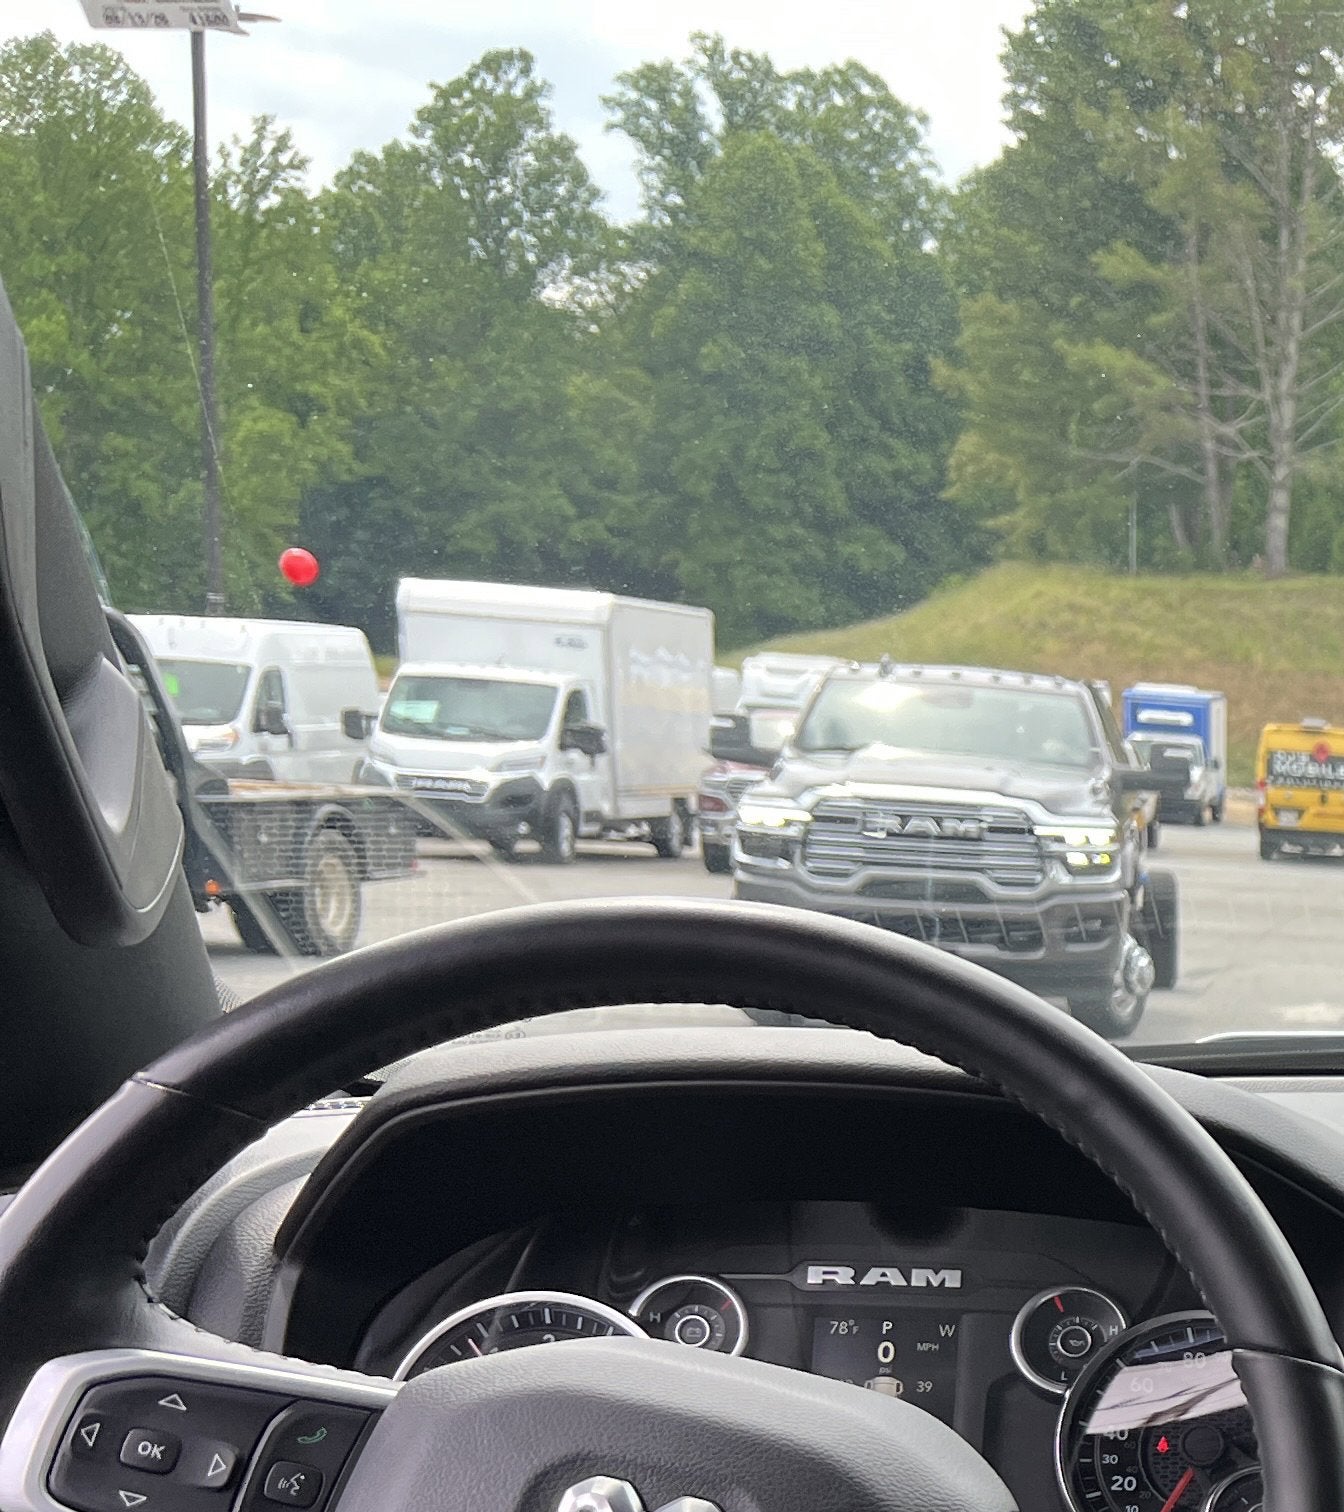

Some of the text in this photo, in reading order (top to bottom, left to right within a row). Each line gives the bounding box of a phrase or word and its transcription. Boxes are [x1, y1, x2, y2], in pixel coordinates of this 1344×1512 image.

[806, 1265, 963, 1288] RAM
[882, 1321, 893, 1335] P
[938, 1324, 956, 1338] W
[1109, 1325, 1119, 1336] H
[877, 1341, 895, 1363] 0
[916, 1342, 939, 1352] MPH
[1060, 1371, 1068, 1381] L
[916, 1380, 933, 1393] 39
[137, 1440, 166, 1461] OK
[1102, 1454, 1118, 1465] 30
[1110, 1475, 1137, 1491] 20
